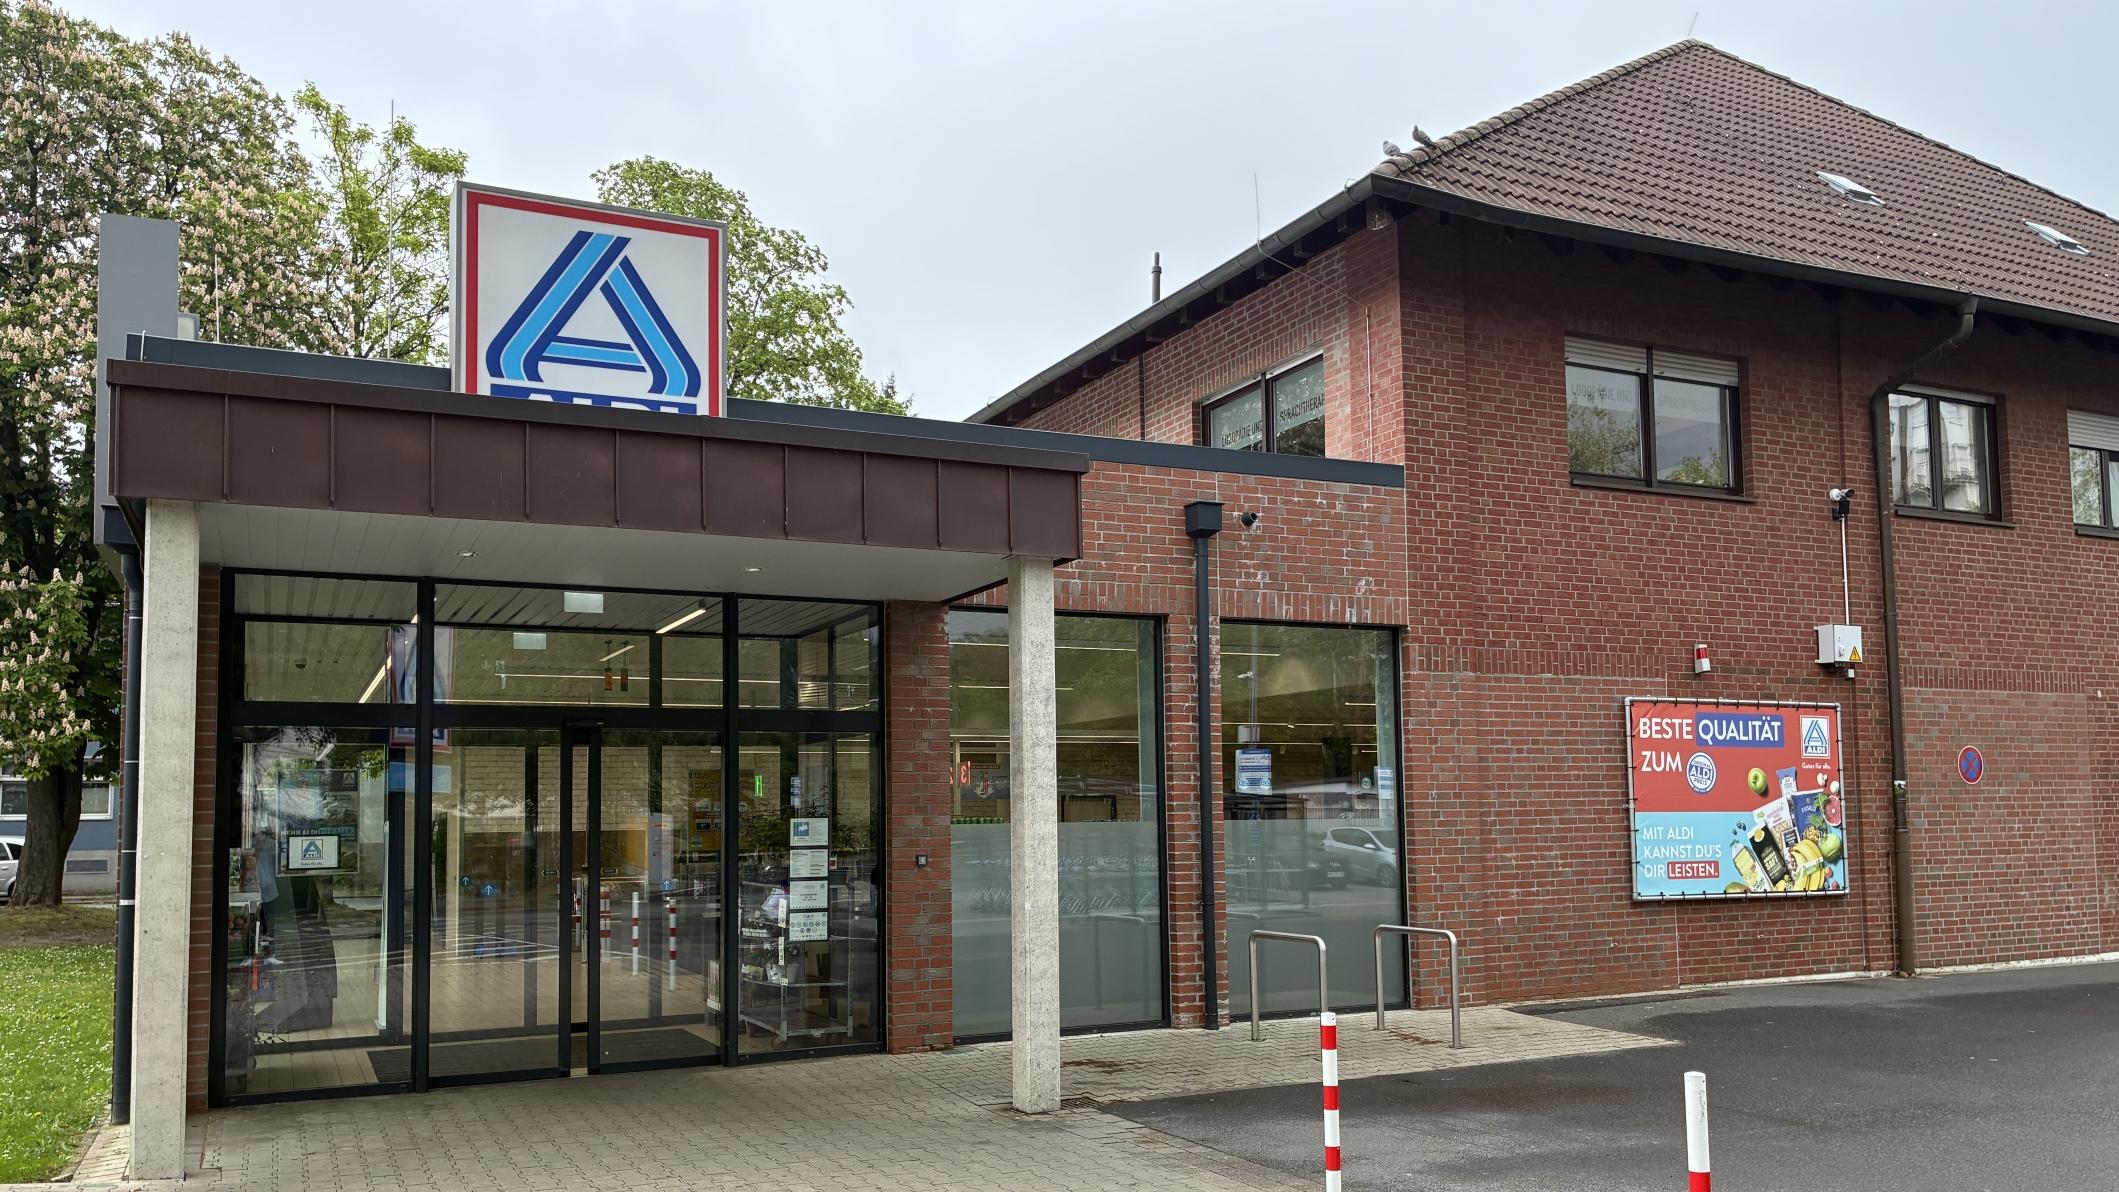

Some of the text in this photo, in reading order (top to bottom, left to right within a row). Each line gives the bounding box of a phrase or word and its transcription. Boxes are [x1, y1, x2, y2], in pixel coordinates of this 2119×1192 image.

[1640, 716, 1781, 745] BESTE QUALITÄT
[1807, 746, 1826, 754] ALDI
[1641, 751, 1682, 772] ZUM
[1690, 766, 1713, 781] ALDI
[1643, 826, 1694, 840] MIT ALDI
[1643, 845, 1722, 859] KANNST DU'S
[1644, 863, 1718, 878] DIR LEISTEN.
[1764, 855, 1779, 871] SAFT
